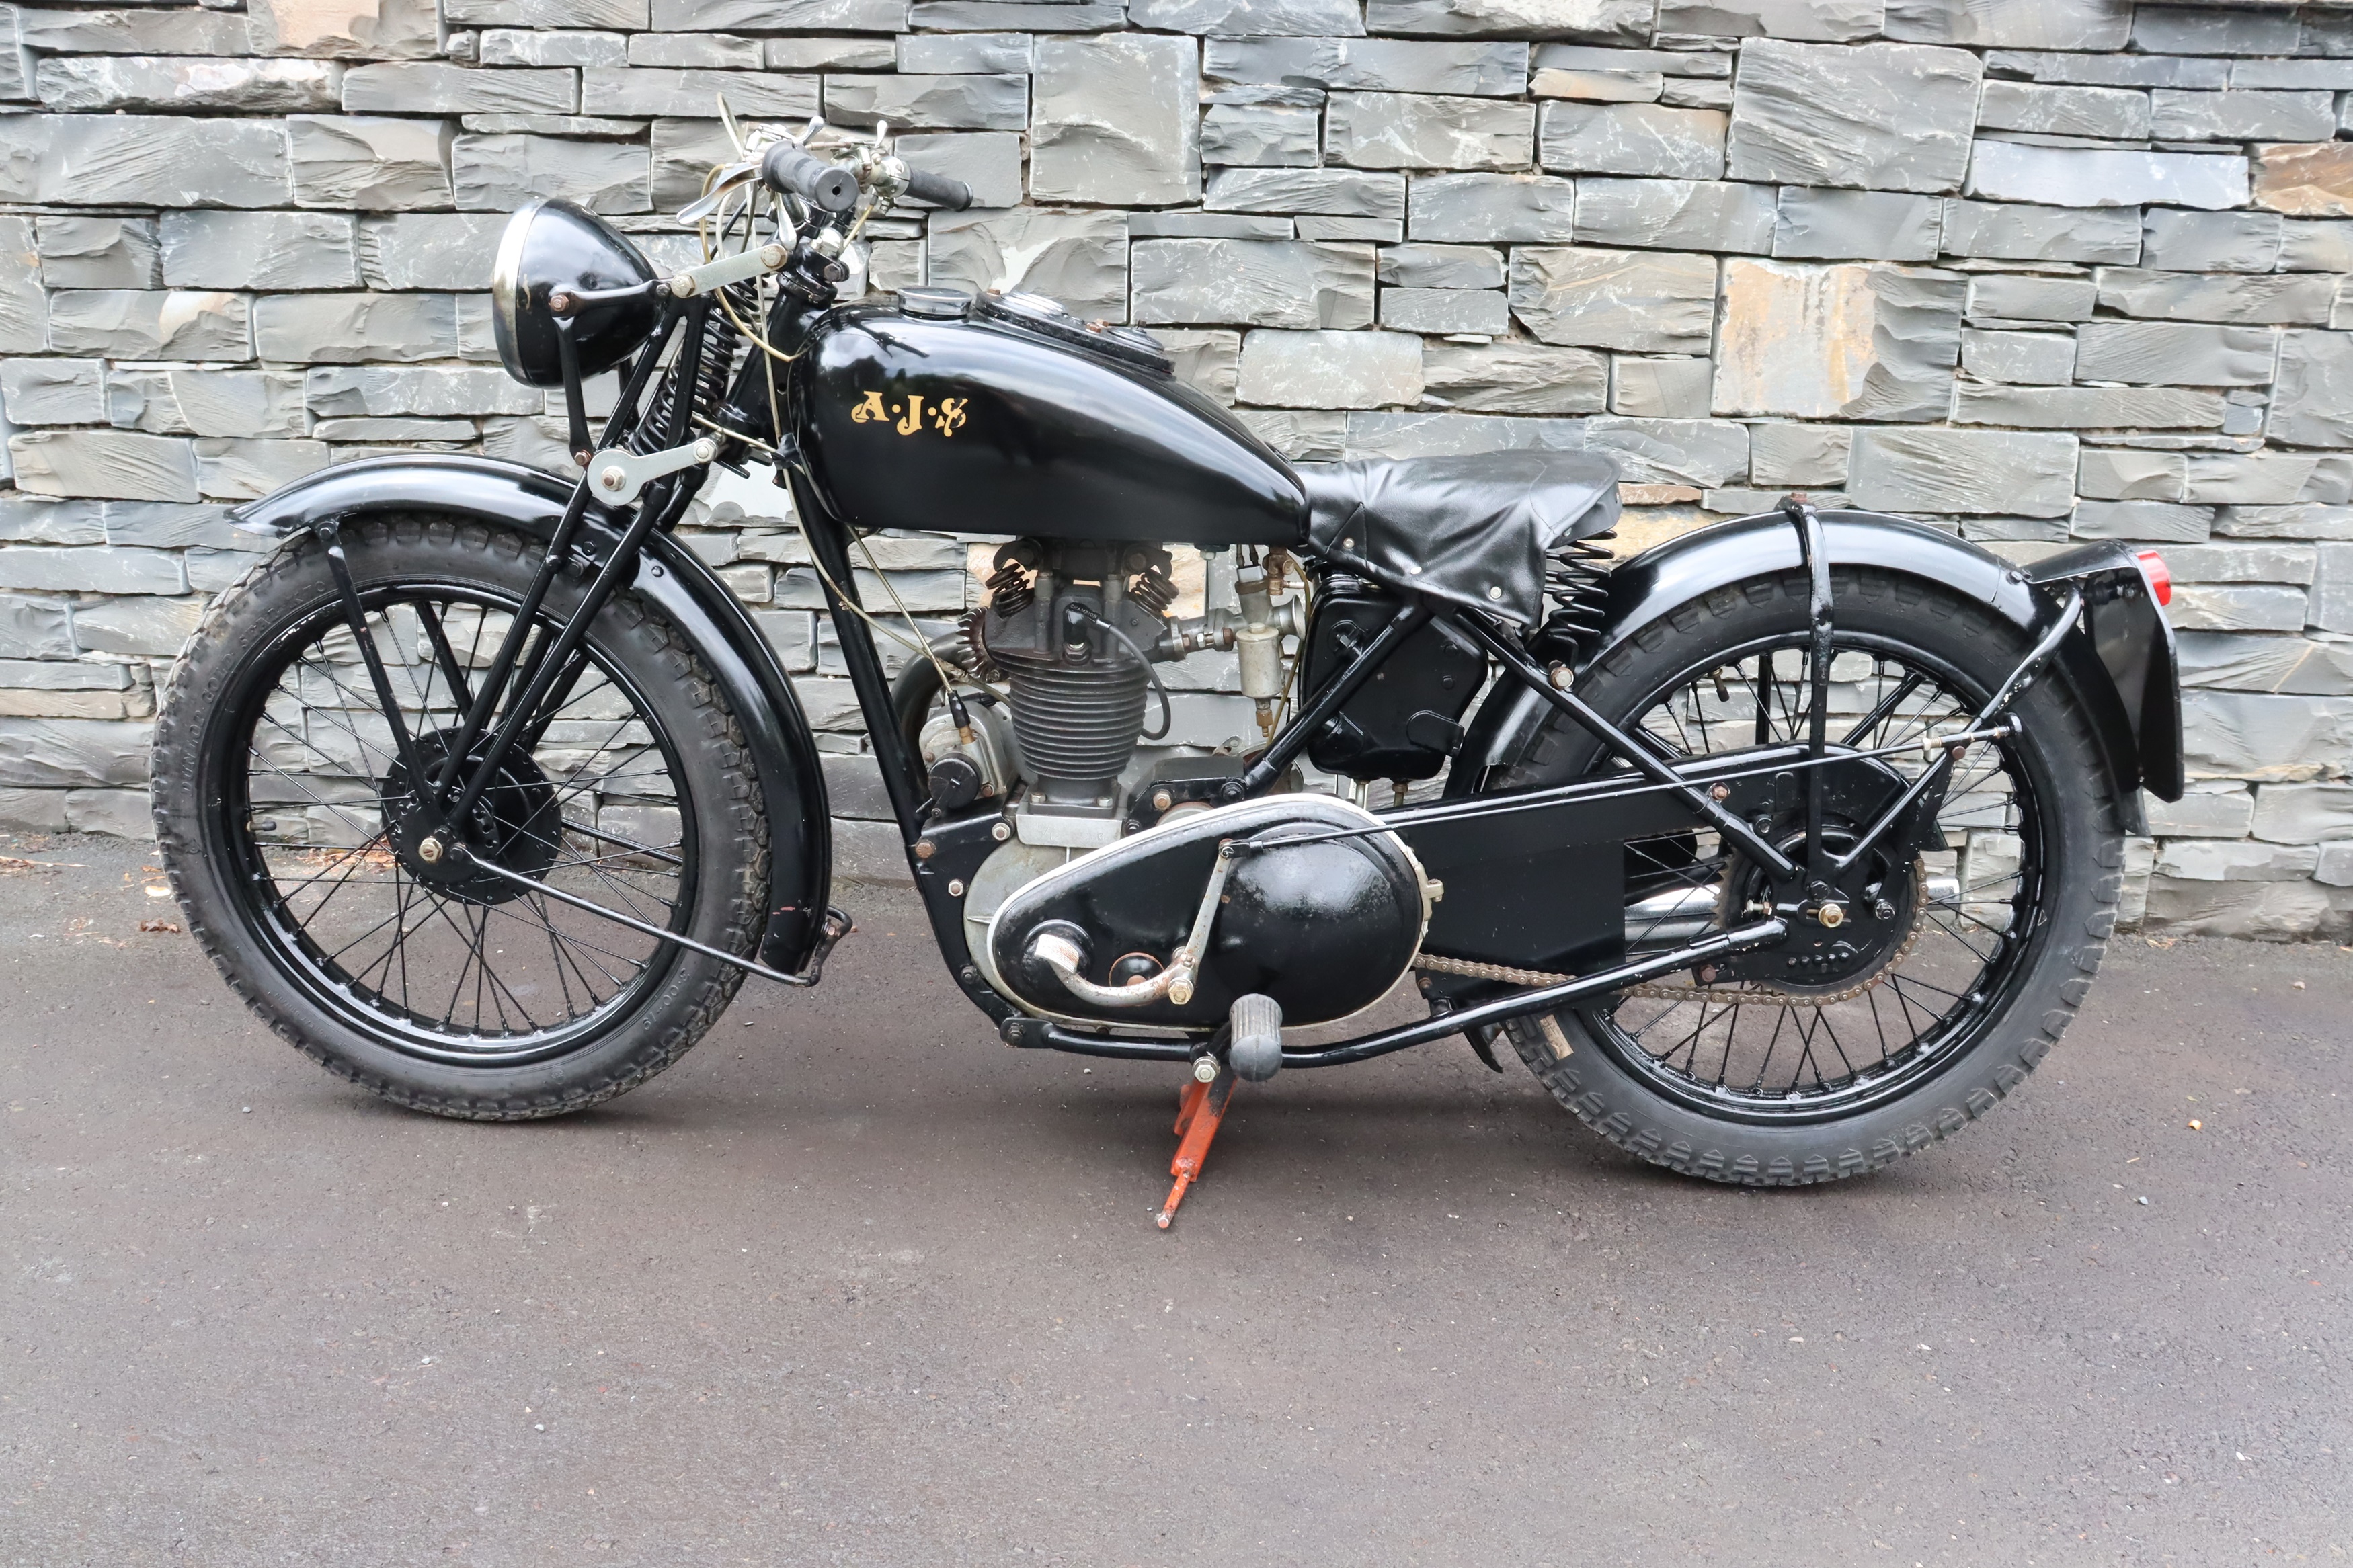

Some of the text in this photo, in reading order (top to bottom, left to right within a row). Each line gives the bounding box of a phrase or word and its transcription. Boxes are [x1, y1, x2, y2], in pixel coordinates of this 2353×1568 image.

[1070, 604, 1099, 619] CHAMPION
[180, 710, 206, 797] DUNLOP
[202, 653, 234, 705] GOLD
[238, 607, 281, 649] SEAL
